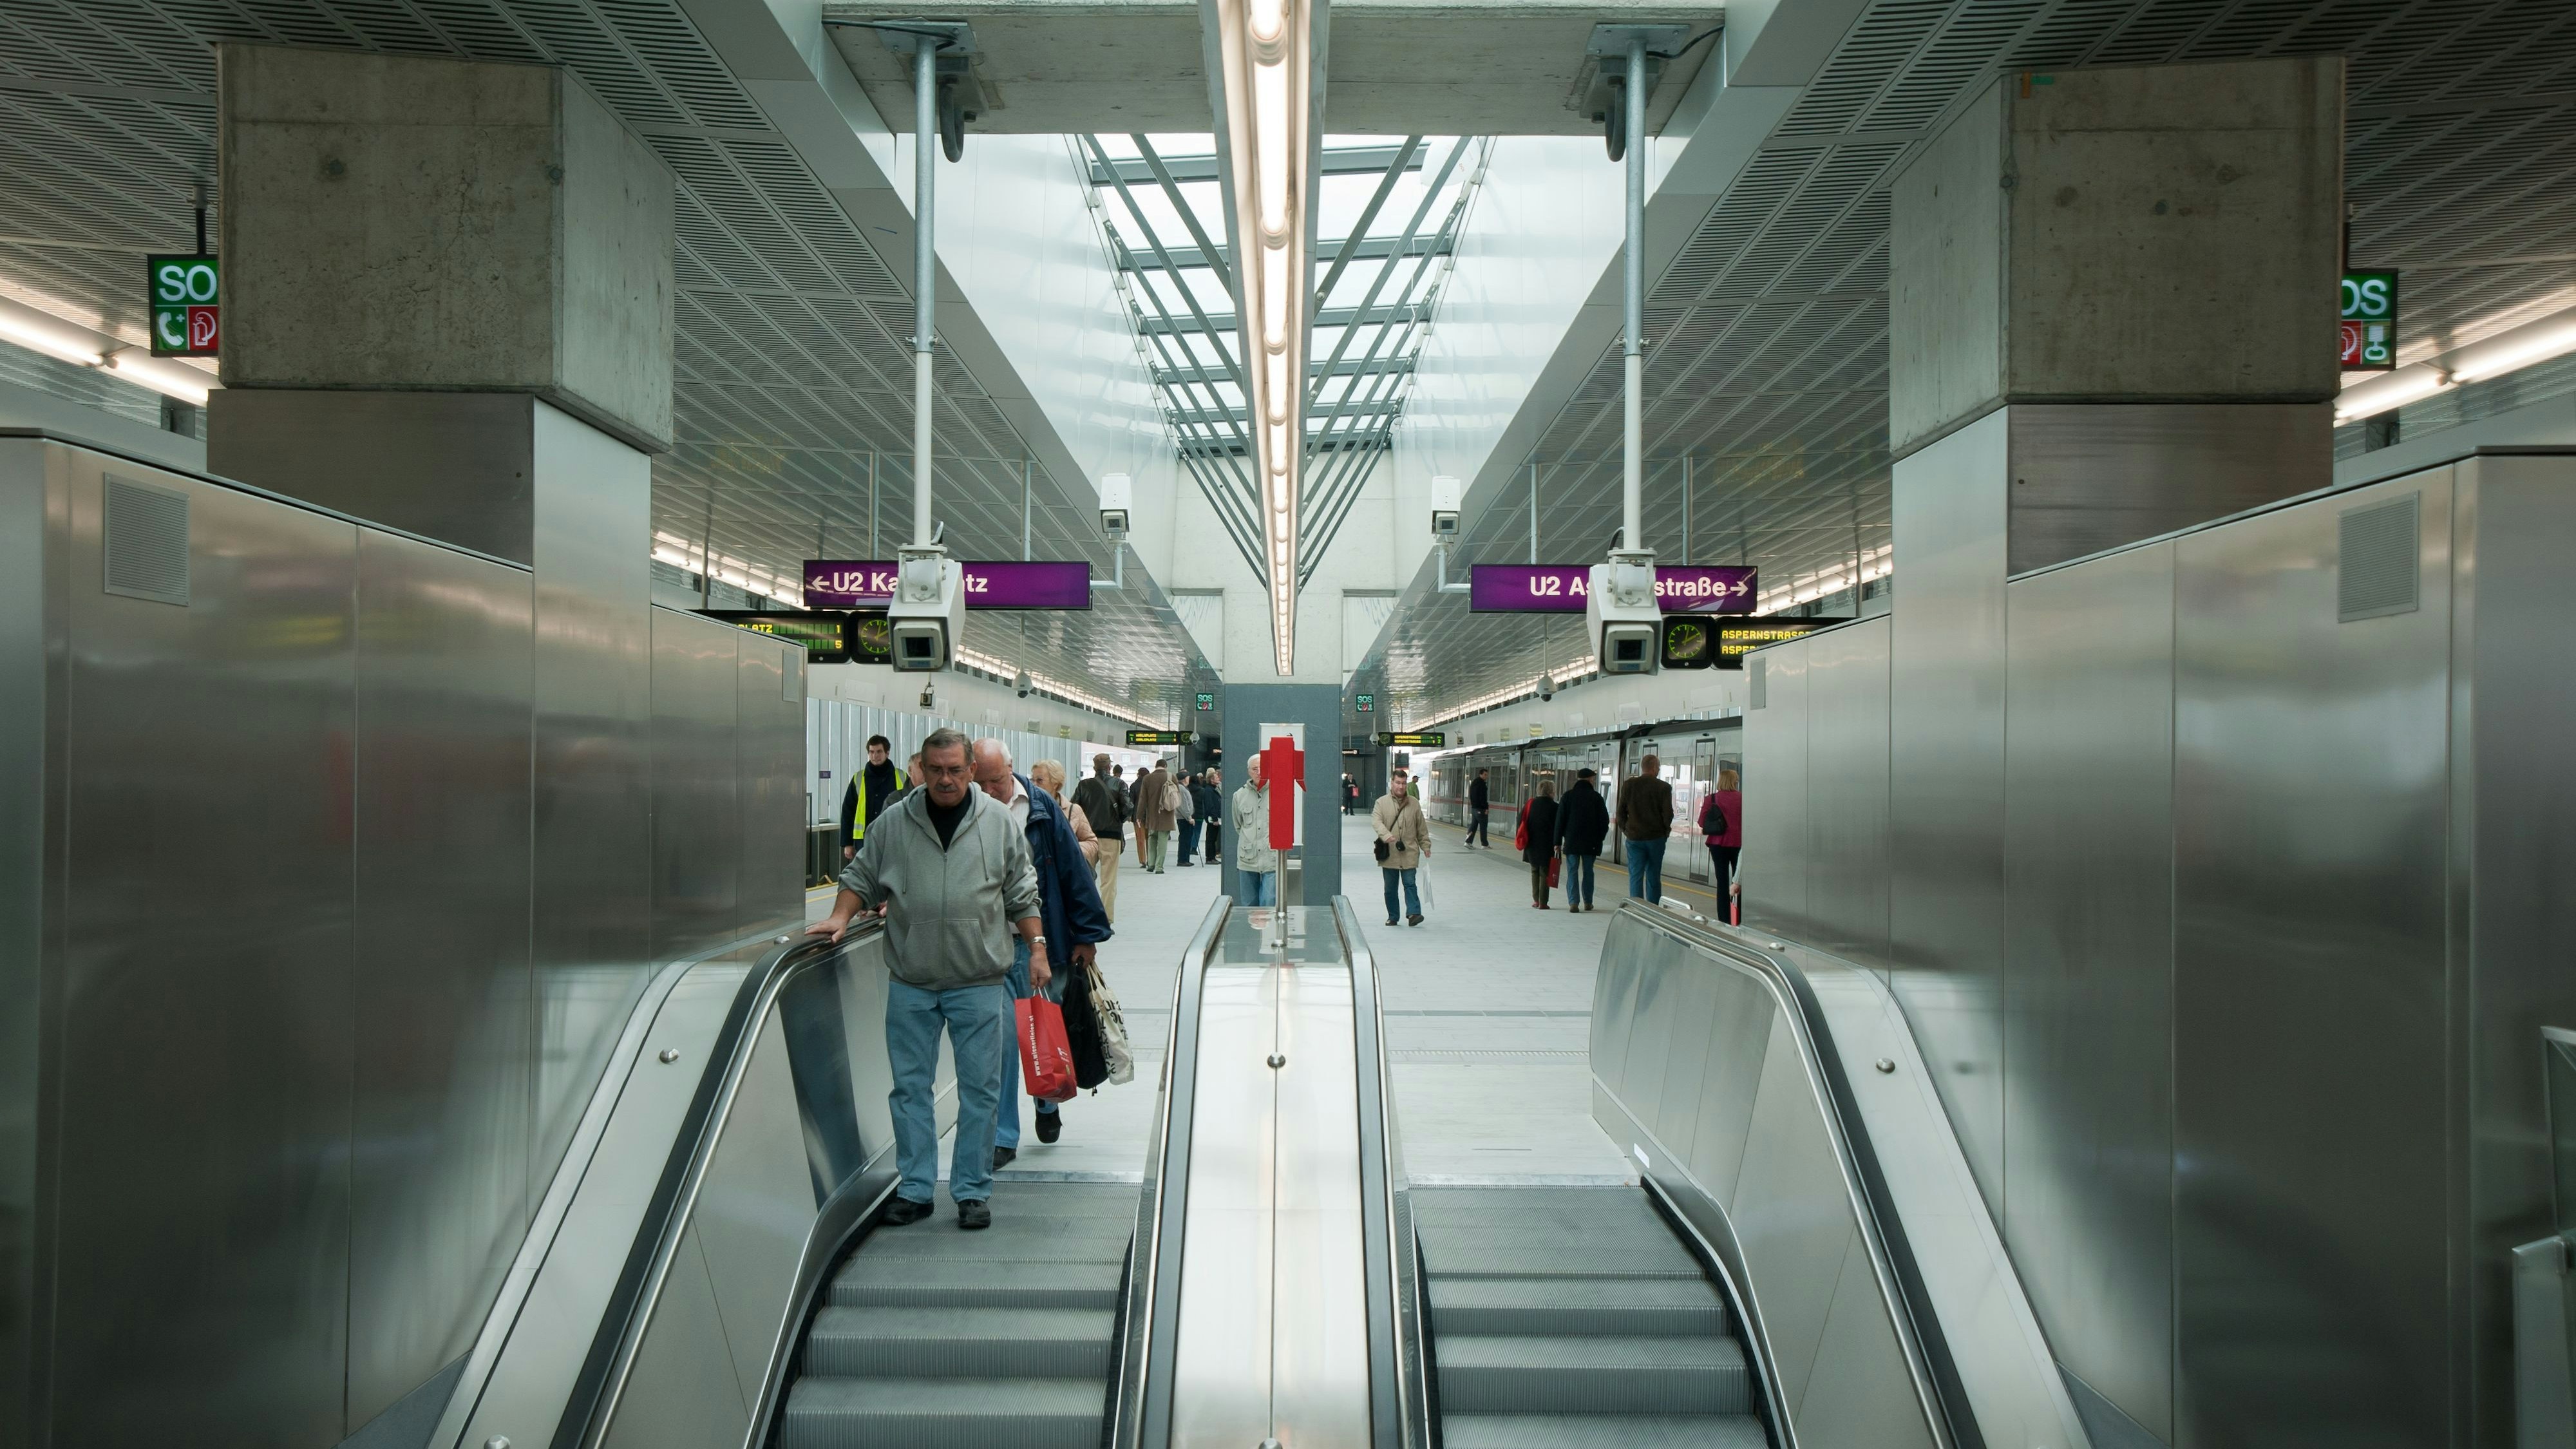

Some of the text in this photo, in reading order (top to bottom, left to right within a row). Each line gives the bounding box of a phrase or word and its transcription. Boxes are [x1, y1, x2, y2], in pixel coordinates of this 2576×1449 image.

[159, 265, 218, 301] SO
[2342, 279, 2387, 316] OS
[833, 573, 864, 592] U2
[1530, 576, 1560, 596] U2
[837, 625, 840, 633] 1
[1722, 630, 1811, 639] ASPERNSTRAS
[835, 639, 842, 649] 5
